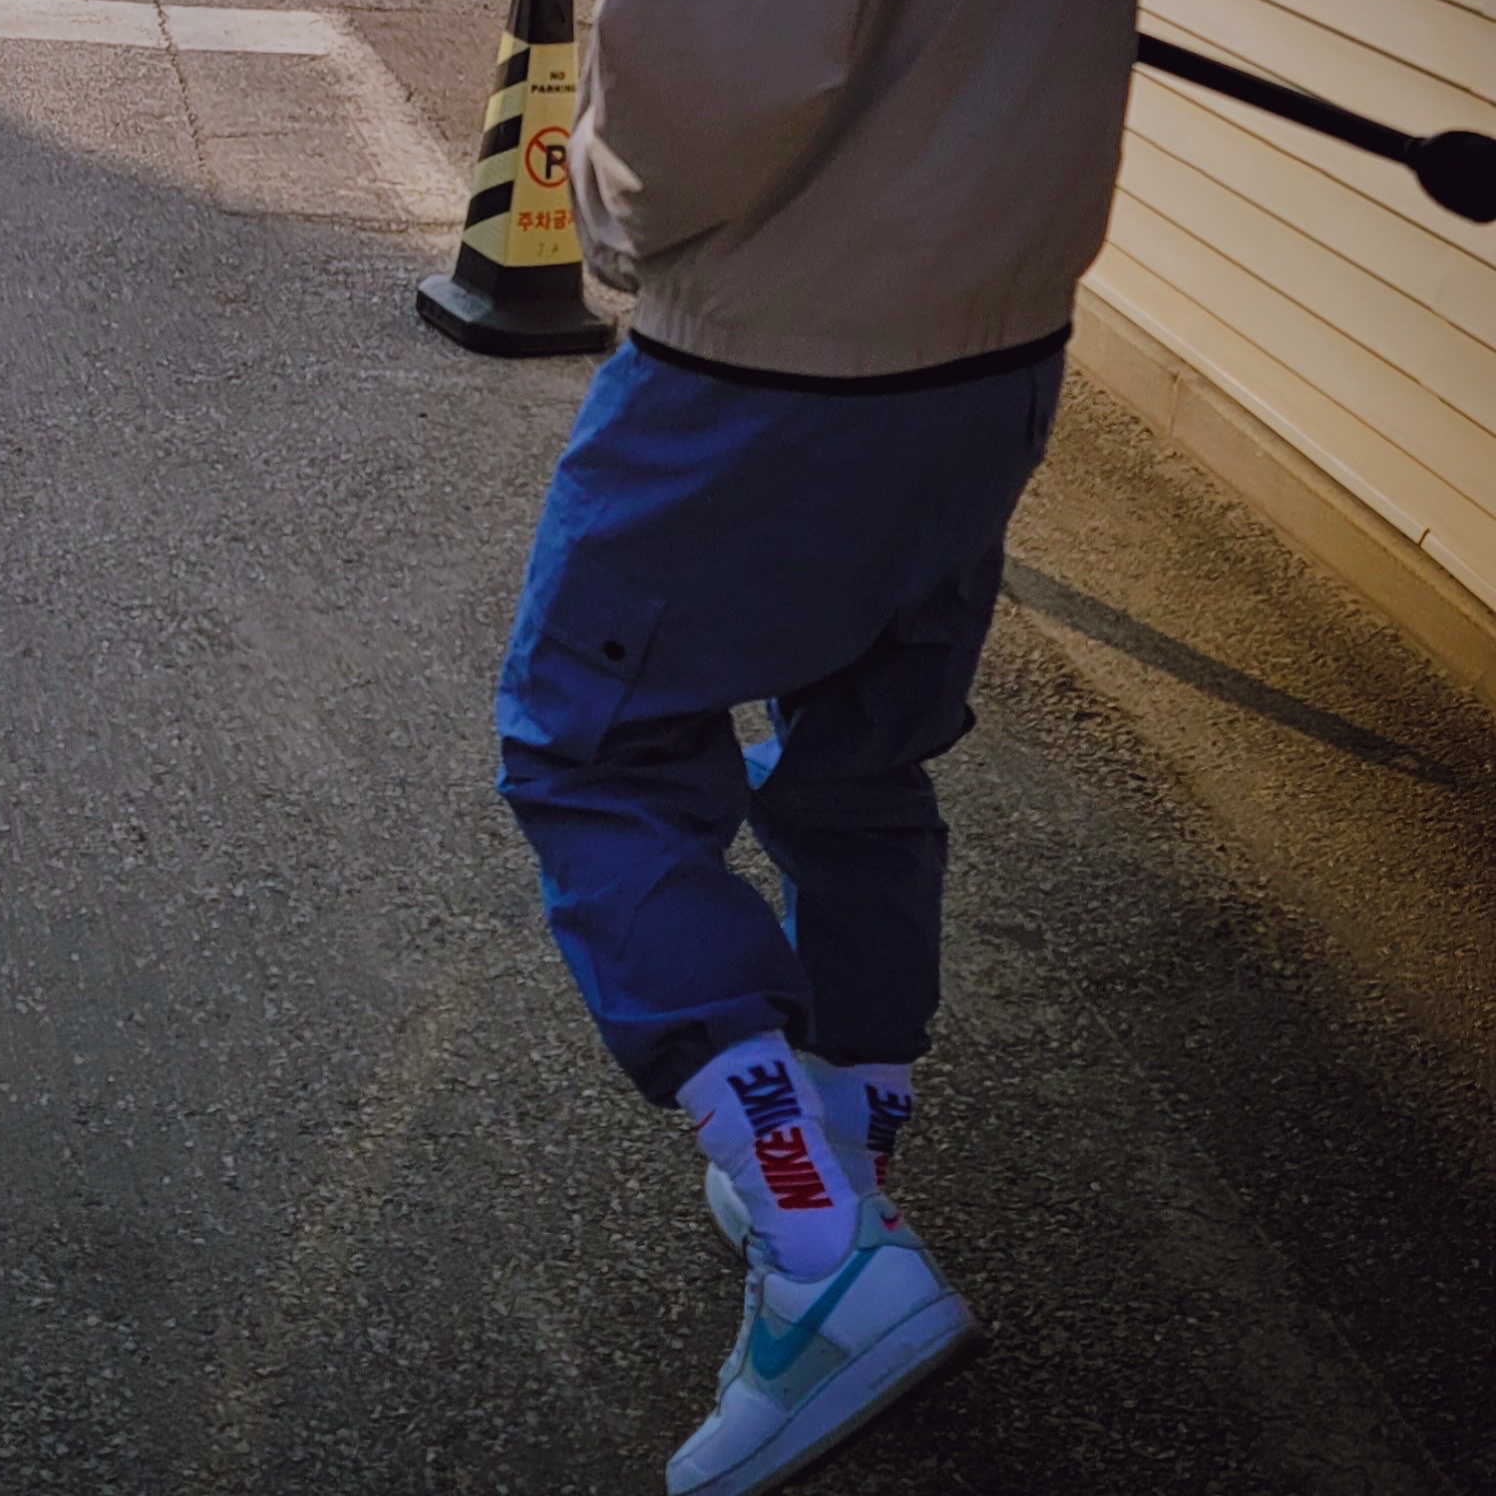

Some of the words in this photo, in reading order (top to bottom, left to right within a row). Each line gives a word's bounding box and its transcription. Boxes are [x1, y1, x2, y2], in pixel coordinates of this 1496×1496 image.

[549, 71, 566, 81] NO
[727, 1059, 802, 1138] NIKE
[755, 1126, 834, 1209] NIKE
